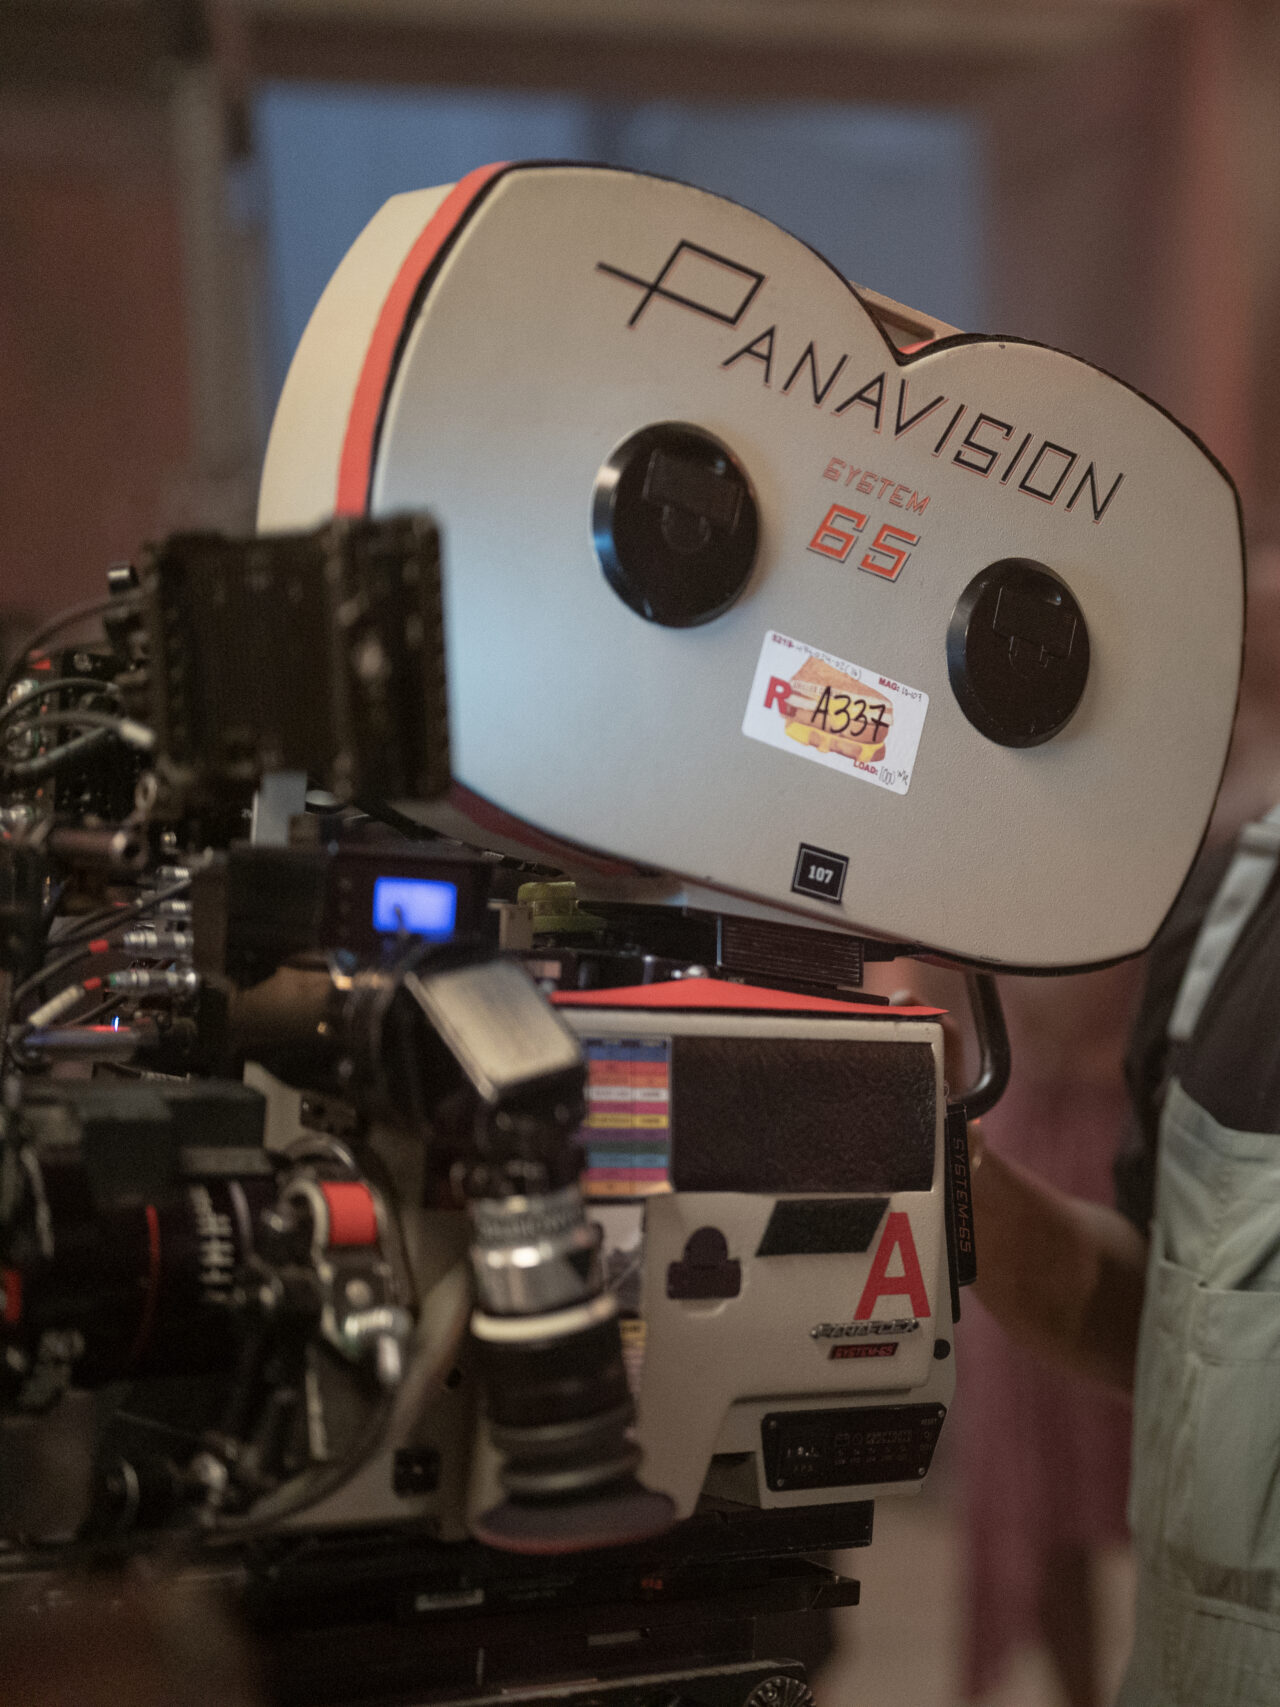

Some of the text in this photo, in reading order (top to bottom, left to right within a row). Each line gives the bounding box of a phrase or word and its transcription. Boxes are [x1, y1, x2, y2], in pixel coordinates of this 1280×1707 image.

[597, 239, 1125, 523] PANAVISION
[822, 456, 932, 516] SYSTEM
[806, 503, 922, 583] 65
[811, 685, 890, 743] A337
[878, 677, 900, 692] MAG:
[853, 760, 879, 776] LOAD:
[808, 864, 835, 884] 107
[952, 1137, 973, 1254] SYSTEM-65
[853, 1212, 931, 1320] A
